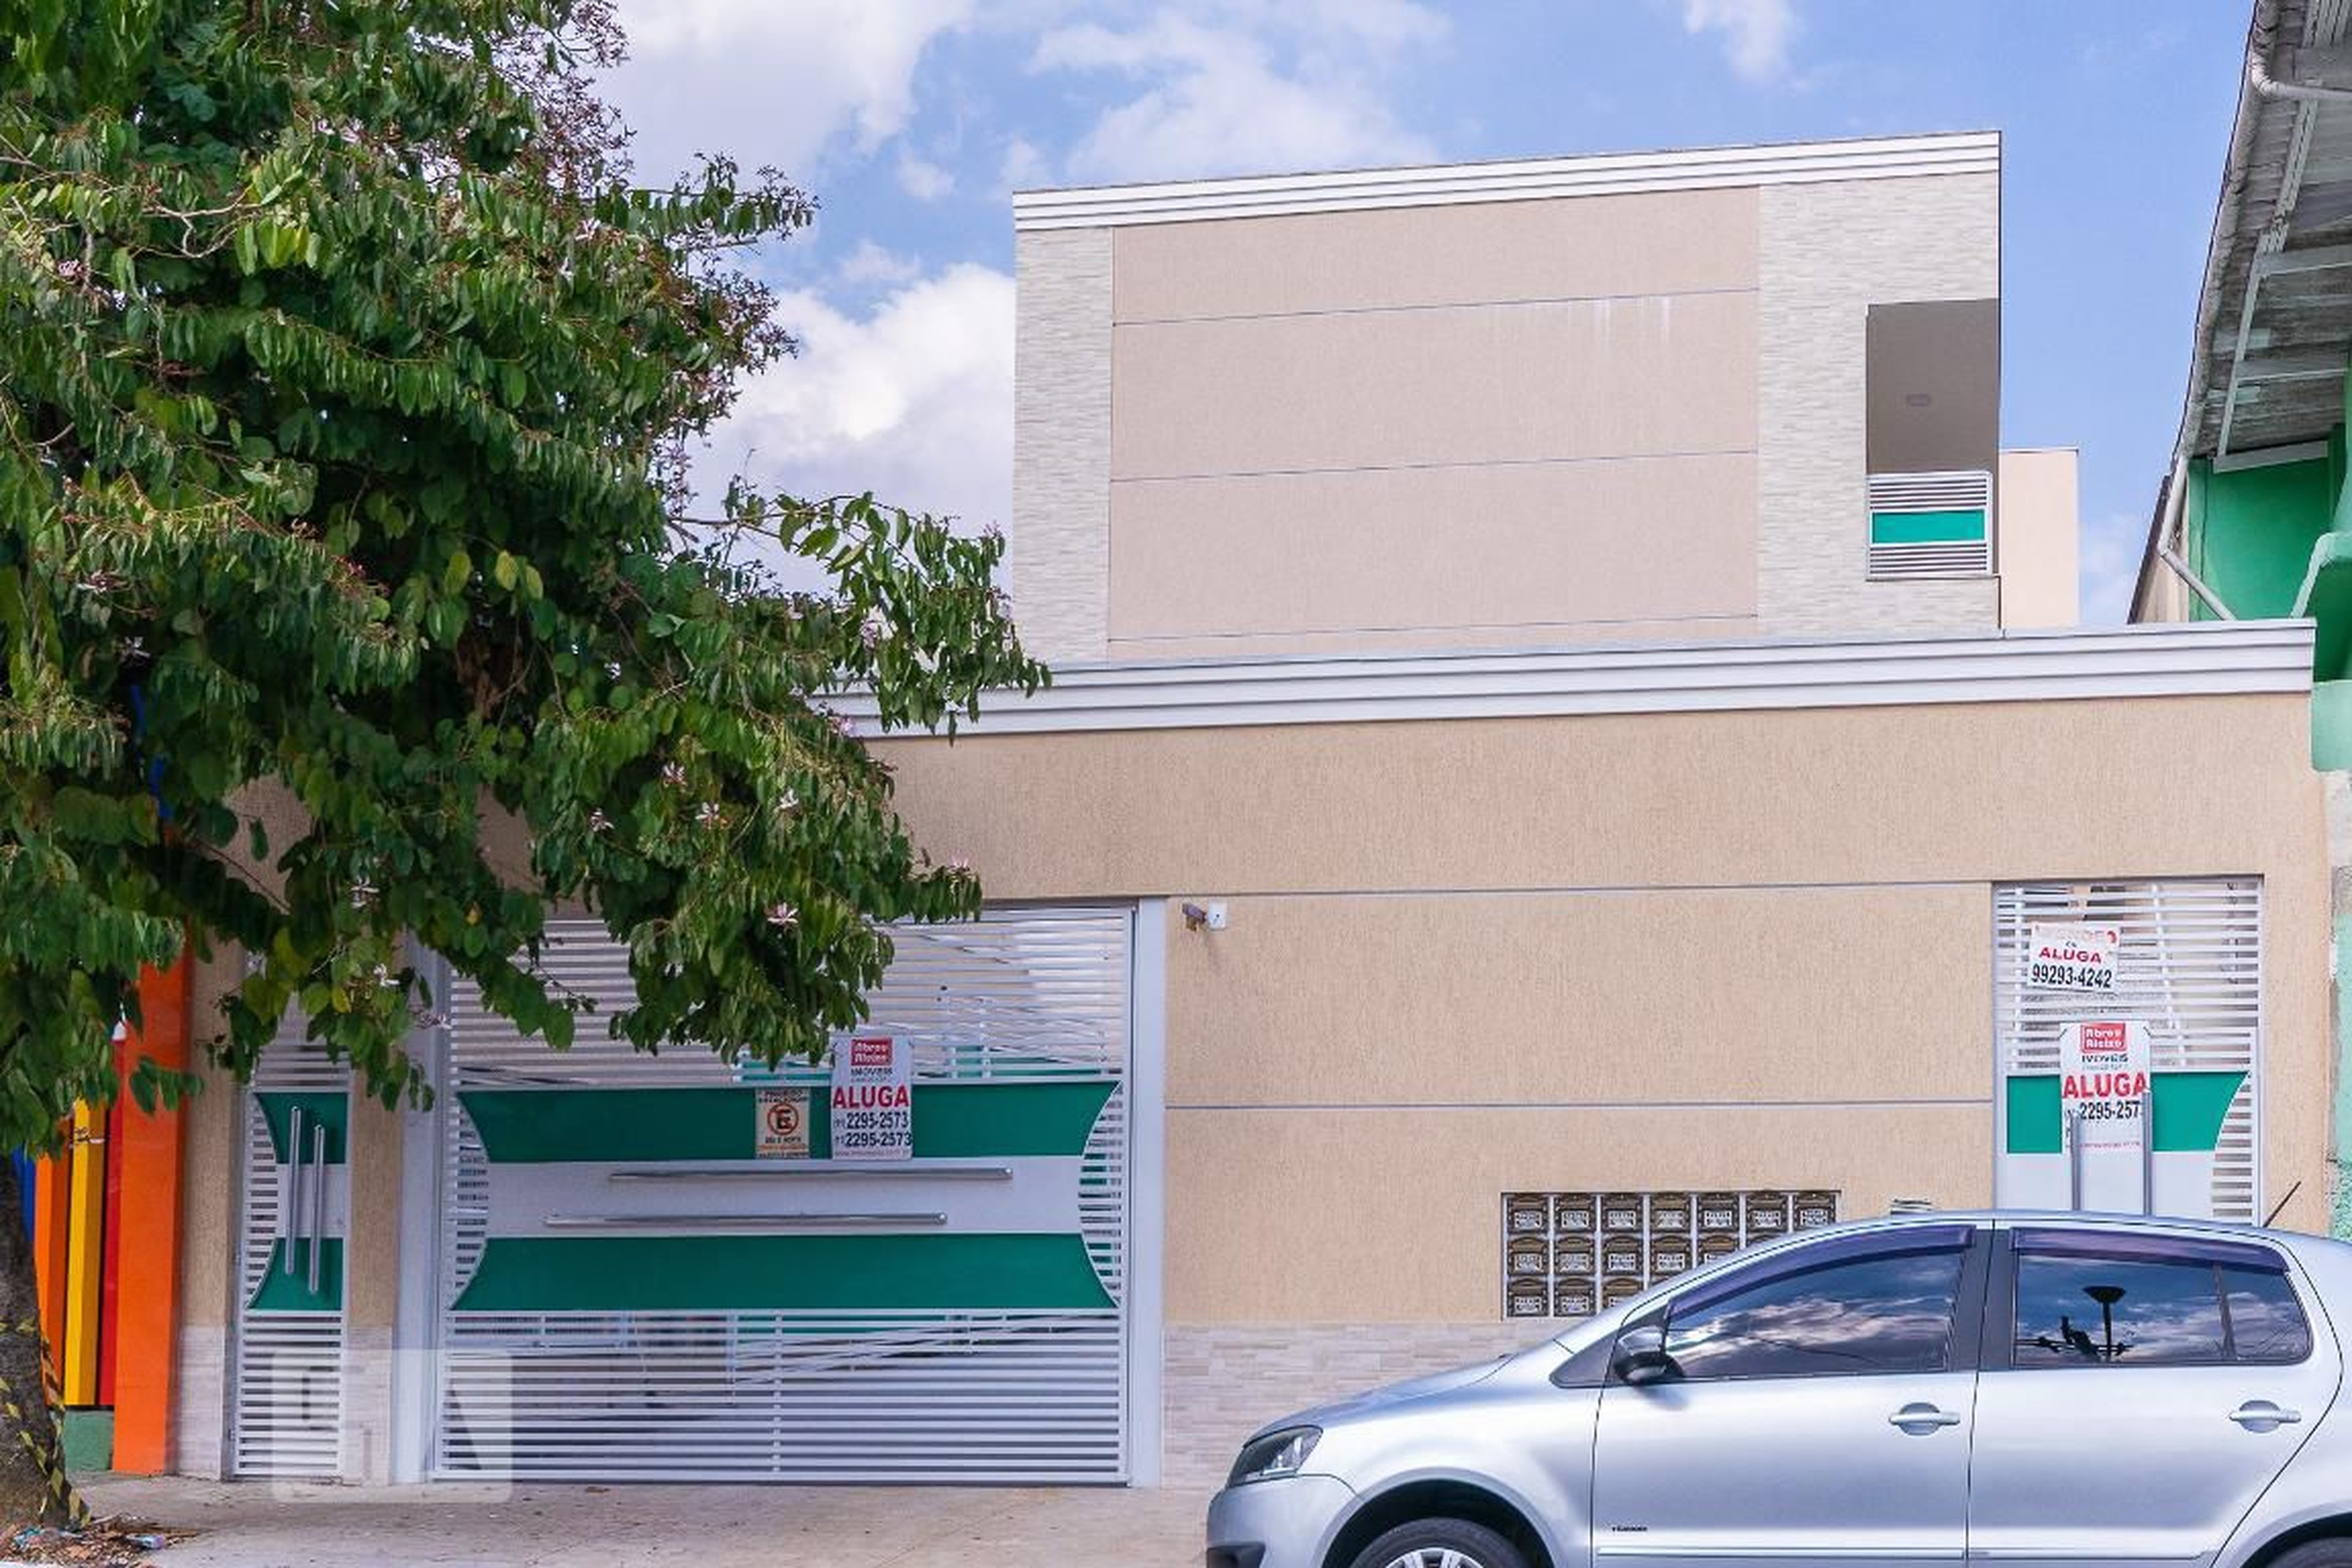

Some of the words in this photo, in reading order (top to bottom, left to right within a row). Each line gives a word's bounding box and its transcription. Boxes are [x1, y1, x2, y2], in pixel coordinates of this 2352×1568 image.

[2039, 946, 2101, 963] ALUGA
[2062, 1072, 2147, 1098] ALUGA
[833, 1085, 909, 1109] ALUGA
[2079, 1099, 2144, 1120] 2295-257
